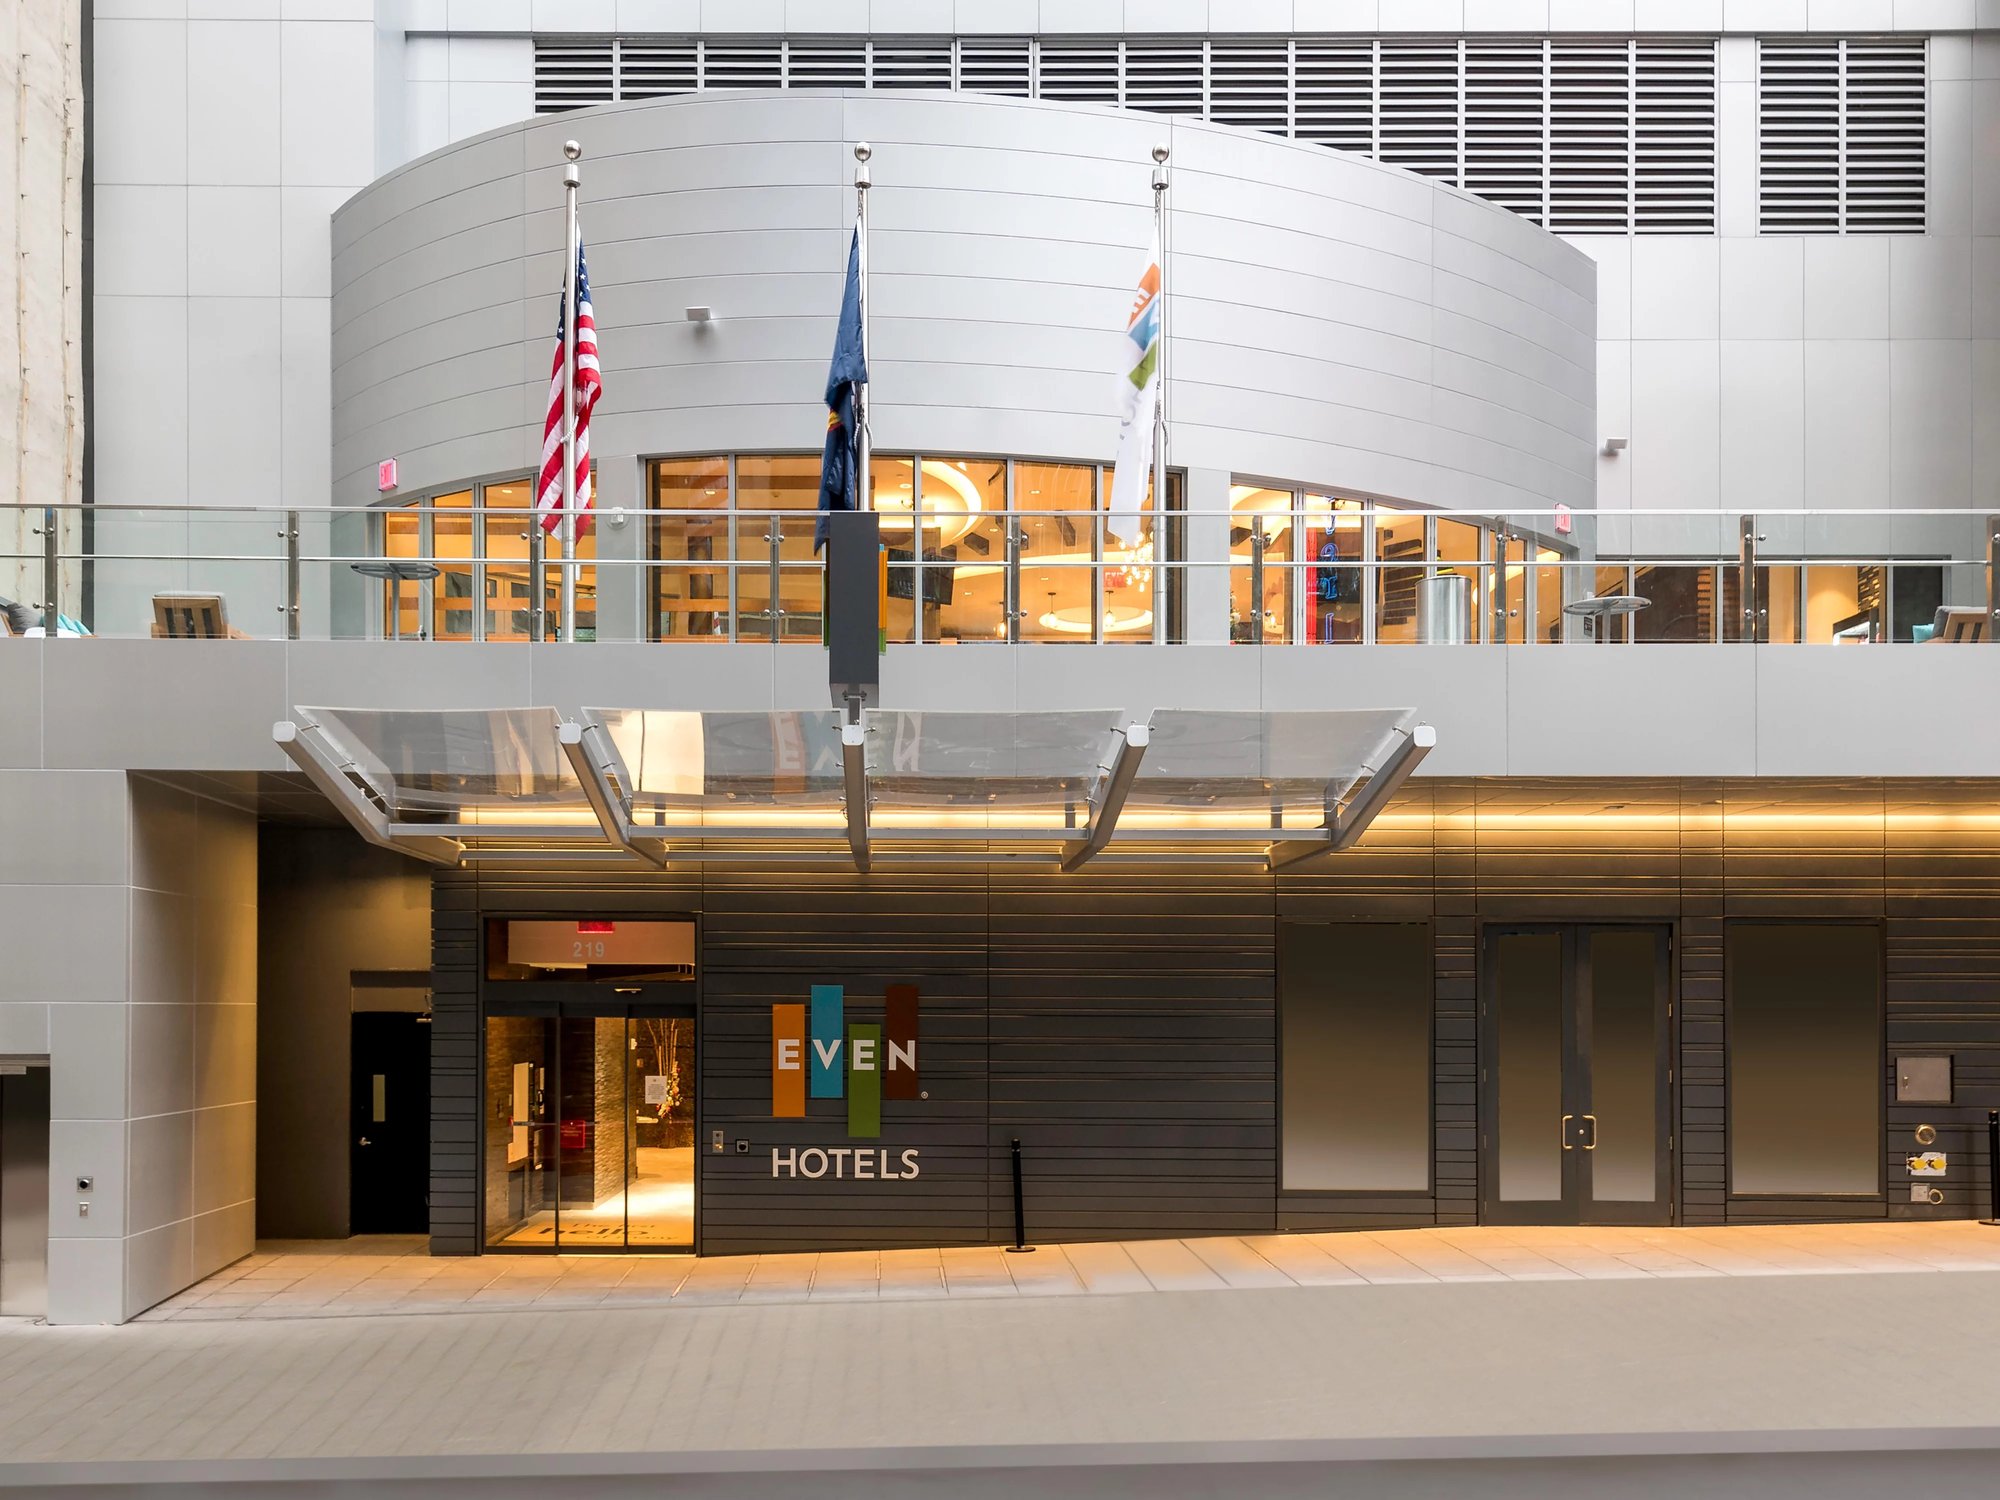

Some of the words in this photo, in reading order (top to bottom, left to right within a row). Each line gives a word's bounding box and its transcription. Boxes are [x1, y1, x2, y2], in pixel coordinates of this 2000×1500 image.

[573, 942, 605, 957] 219
[777, 1039, 916, 1072] EVEN
[772, 1147, 920, 1180] HOTELS
